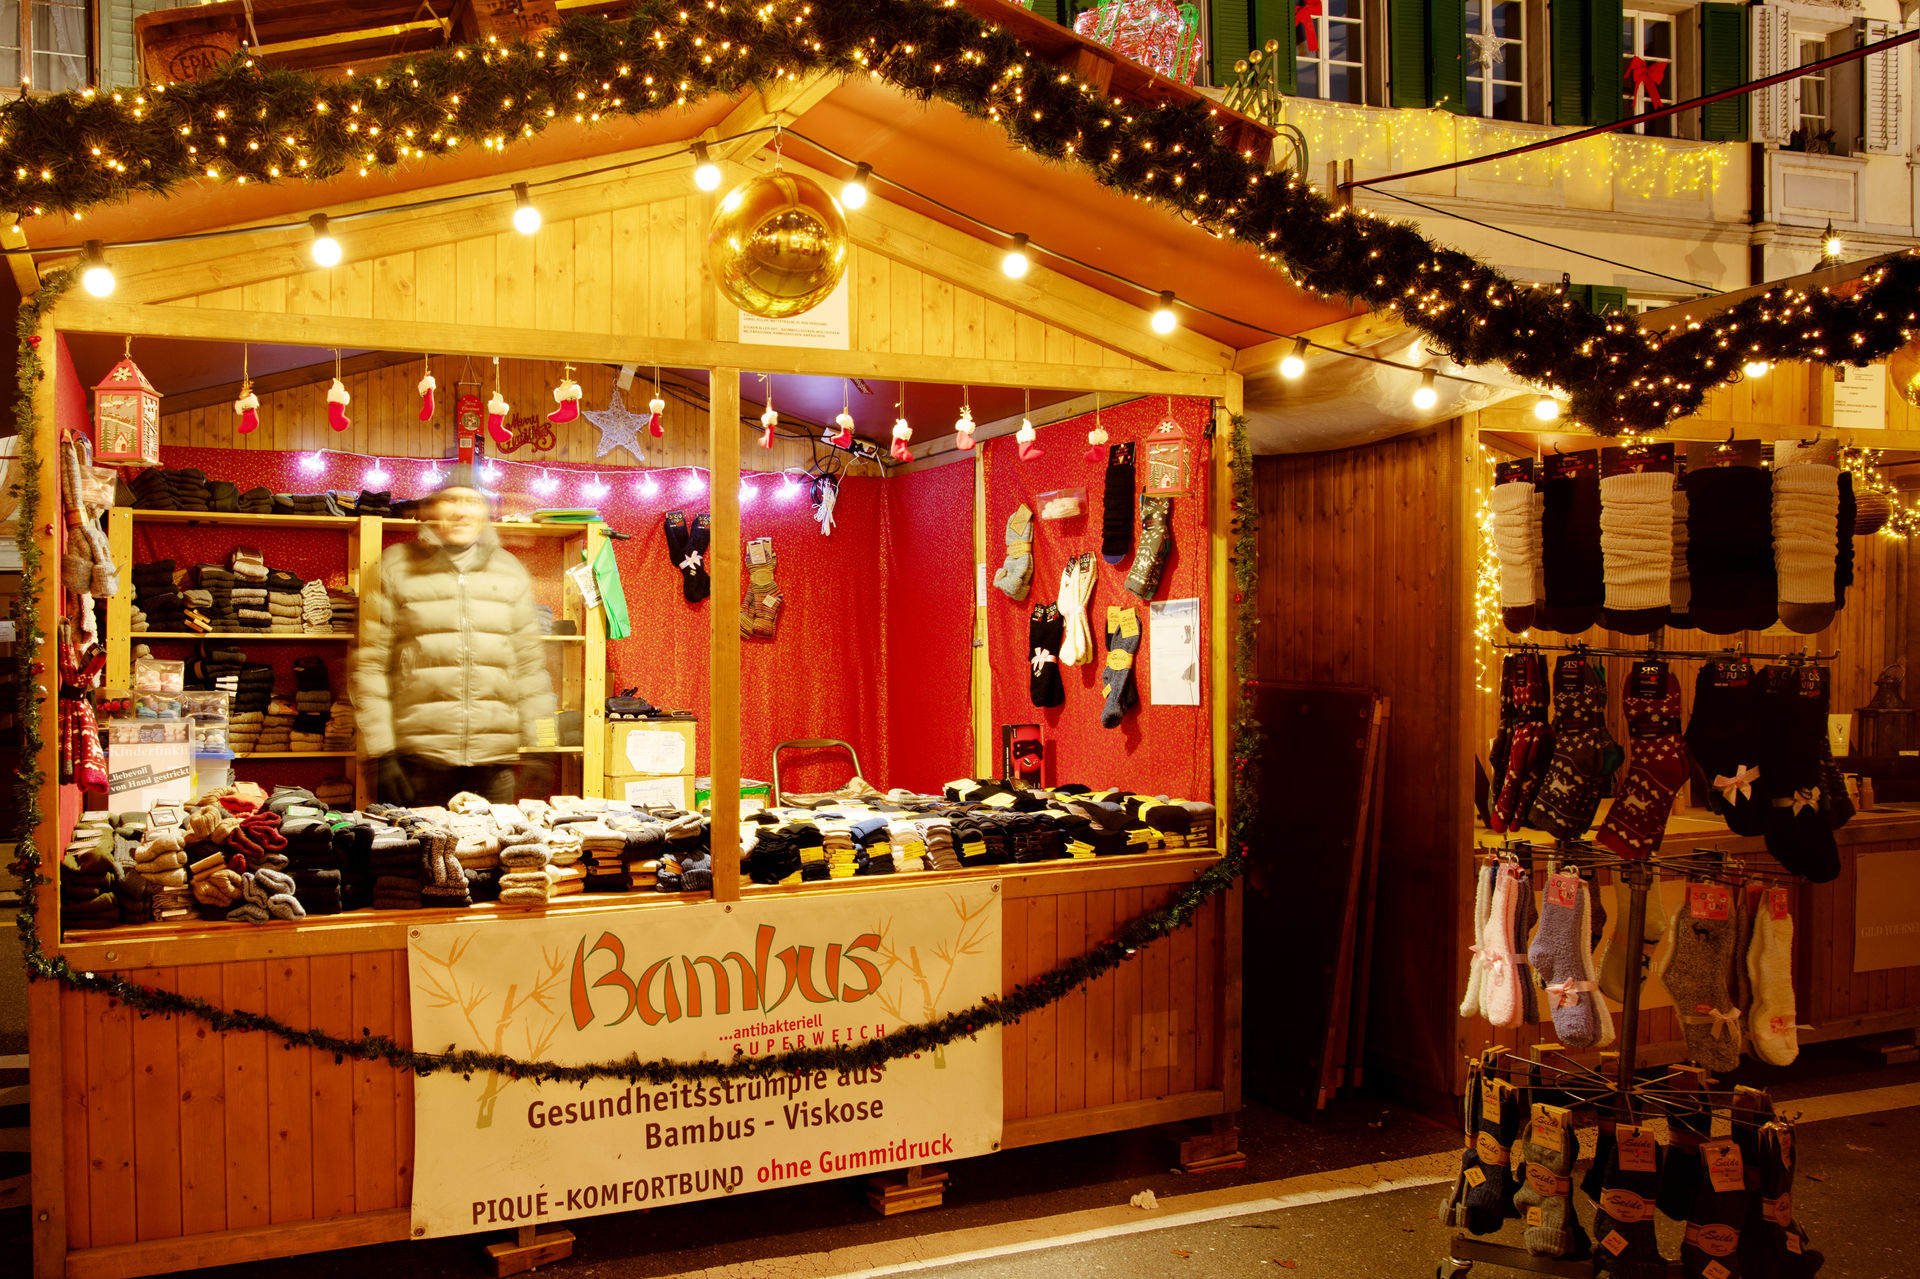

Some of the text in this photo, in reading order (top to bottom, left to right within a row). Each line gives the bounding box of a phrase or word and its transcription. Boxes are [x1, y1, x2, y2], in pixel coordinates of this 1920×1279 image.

[111, 767, 190, 792] von Hand gestrickt
[570, 924, 883, 1032] Bambus
[733, 1023, 886, 1058] SUPERWEICH
[528, 1066, 883, 1129] Gesundheitsstrümpfe aus
[645, 1116, 756, 1150] Bambus
[783, 1097, 884, 1131] Viskose
[757, 1158, 812, 1183] ohne
[819, 1132, 954, 1174] Gummidruck
